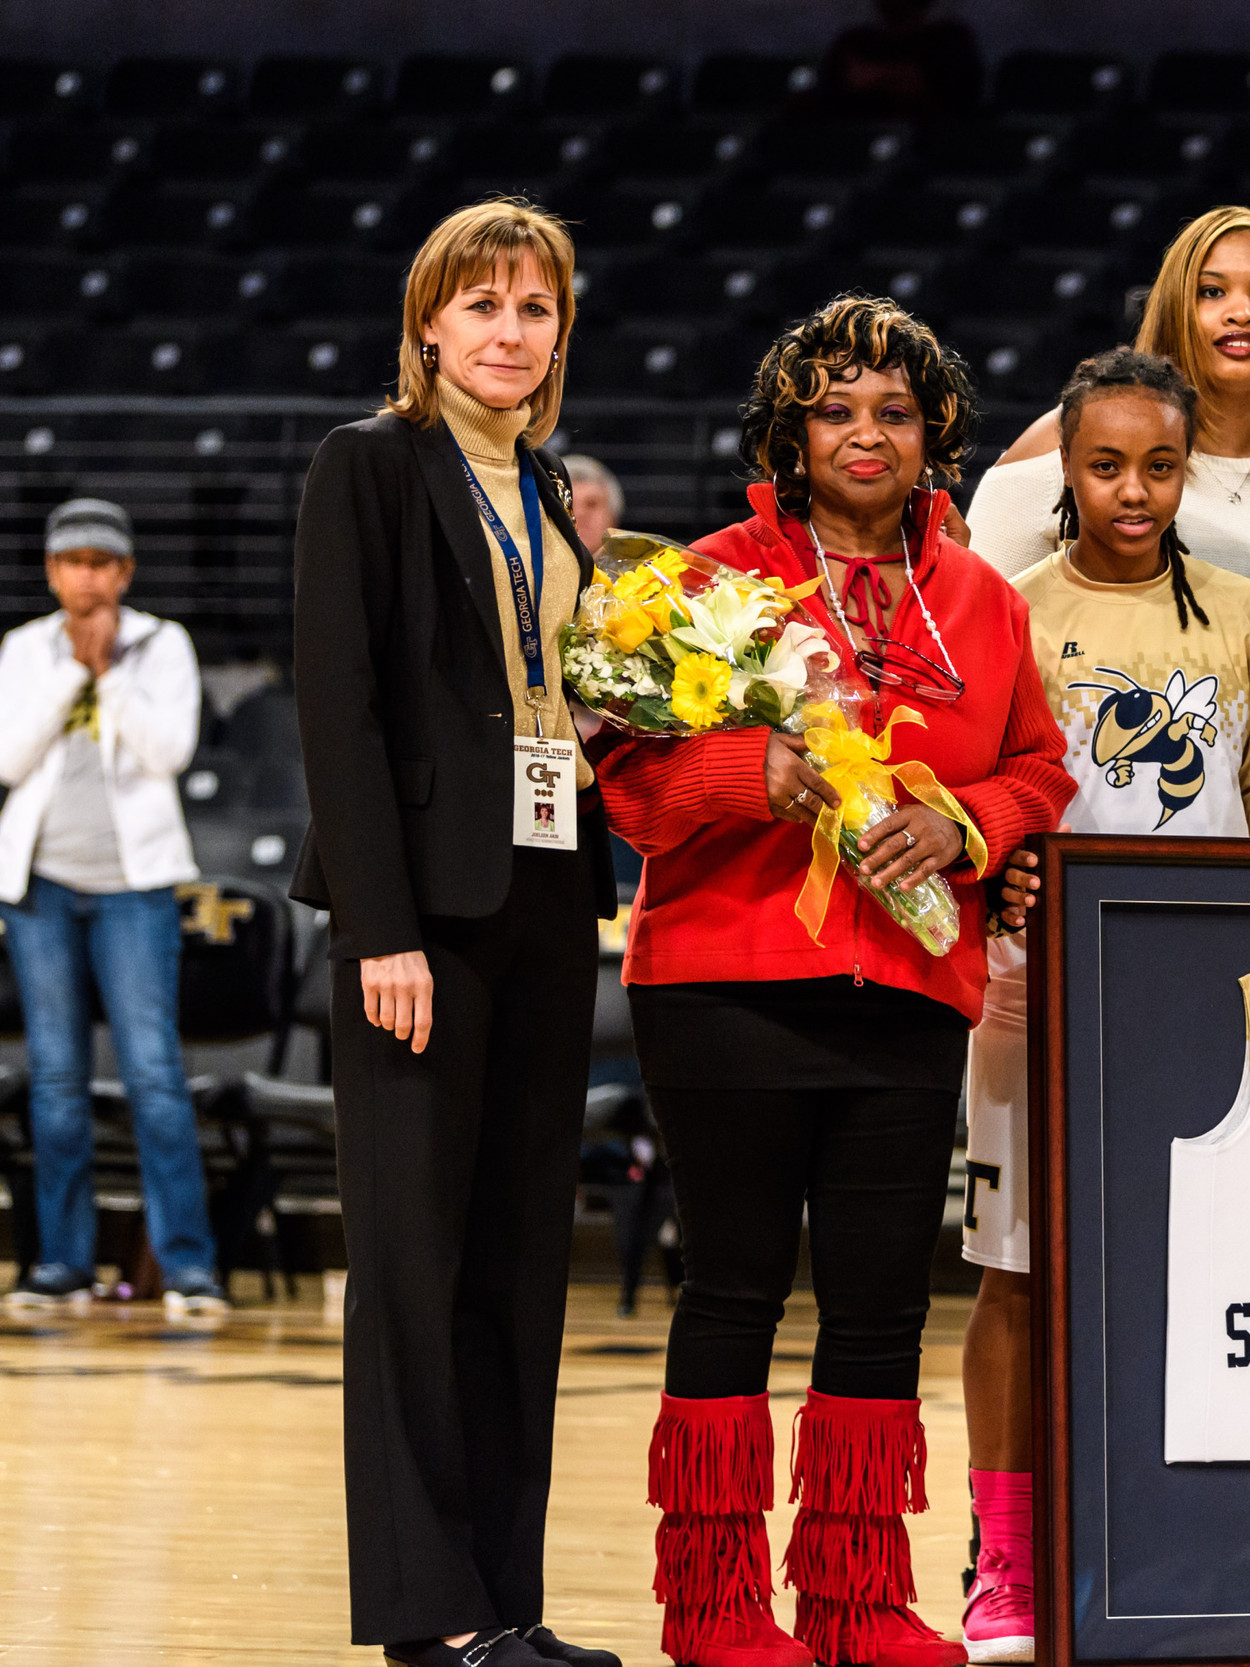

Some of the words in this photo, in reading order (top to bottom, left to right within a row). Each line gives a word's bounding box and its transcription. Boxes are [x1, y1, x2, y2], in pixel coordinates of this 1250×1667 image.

[469, 483, 496, 522] GEORGIA
[509, 557, 524, 586] TECH
[516, 585, 532, 631] GEORGIA
[524, 636, 537, 659] GT
[514, 744, 549, 754] GEORGIA
[551, 747, 573, 757] TECH
[526, 762, 561, 788] GT
